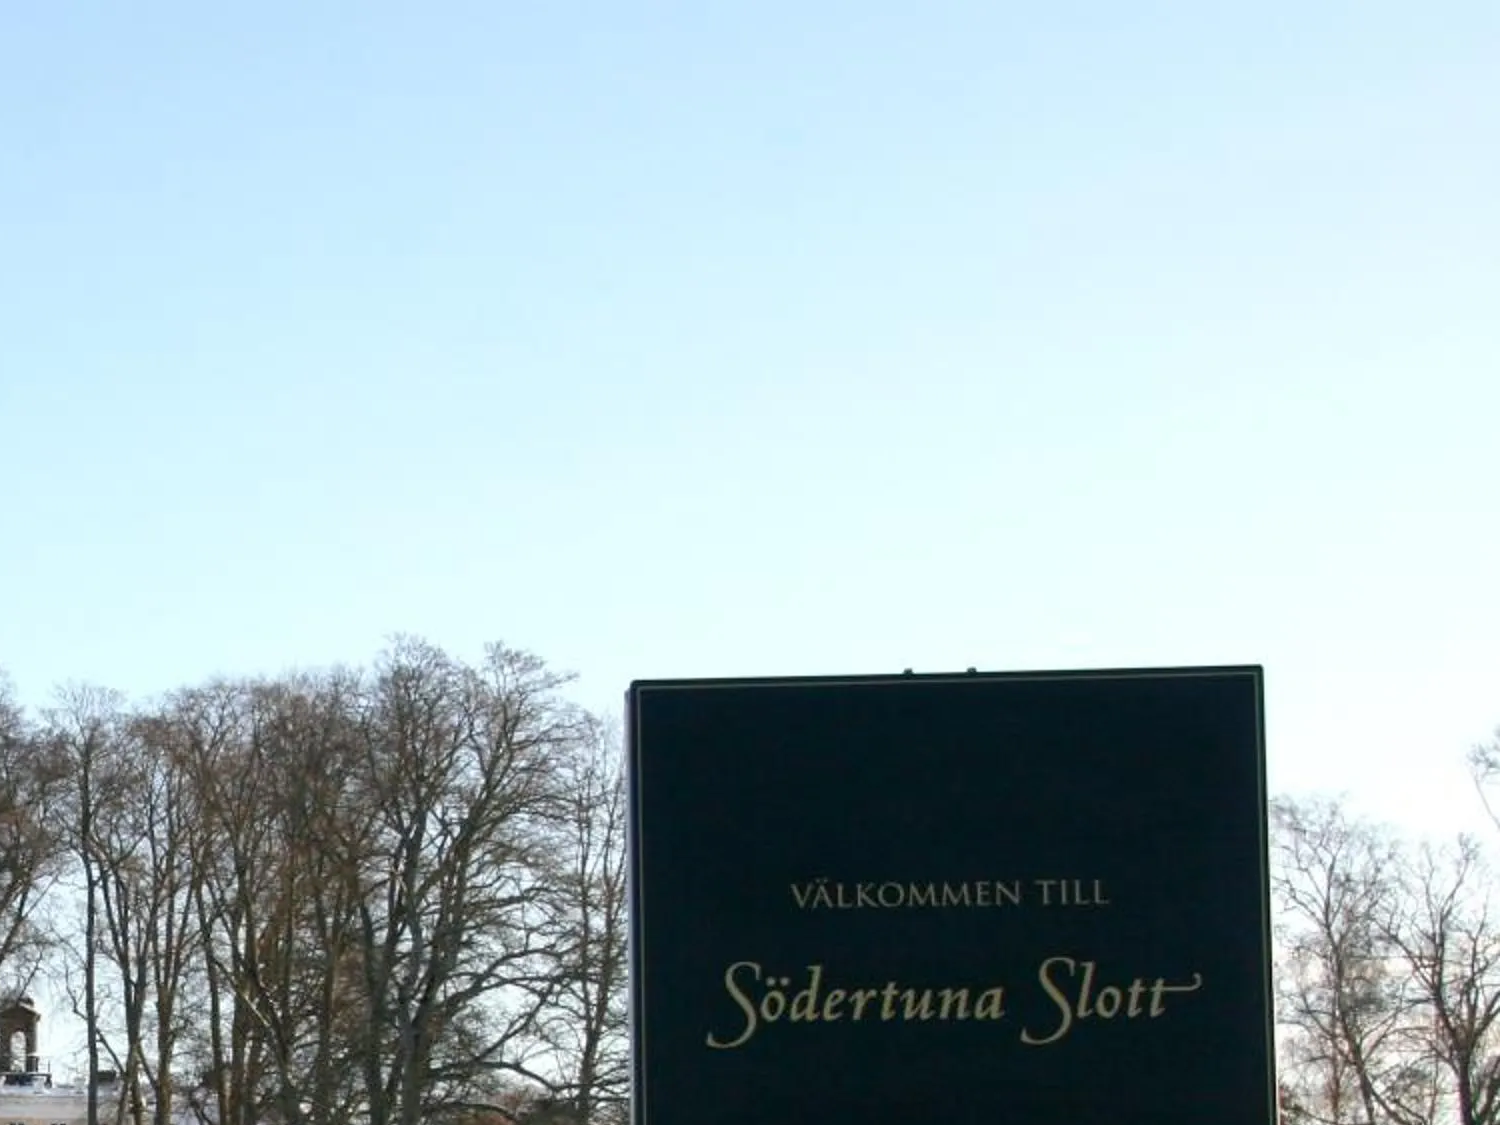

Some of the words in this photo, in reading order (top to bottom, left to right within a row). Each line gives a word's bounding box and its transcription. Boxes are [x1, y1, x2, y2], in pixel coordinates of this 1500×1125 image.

[790, 879, 1022, 909] VÄLKOMMEN
[1036, 879, 1109, 906] TILL
[706, 961, 1005, 1049] Södertuna
[1020, 957, 1203, 1045] Slott
